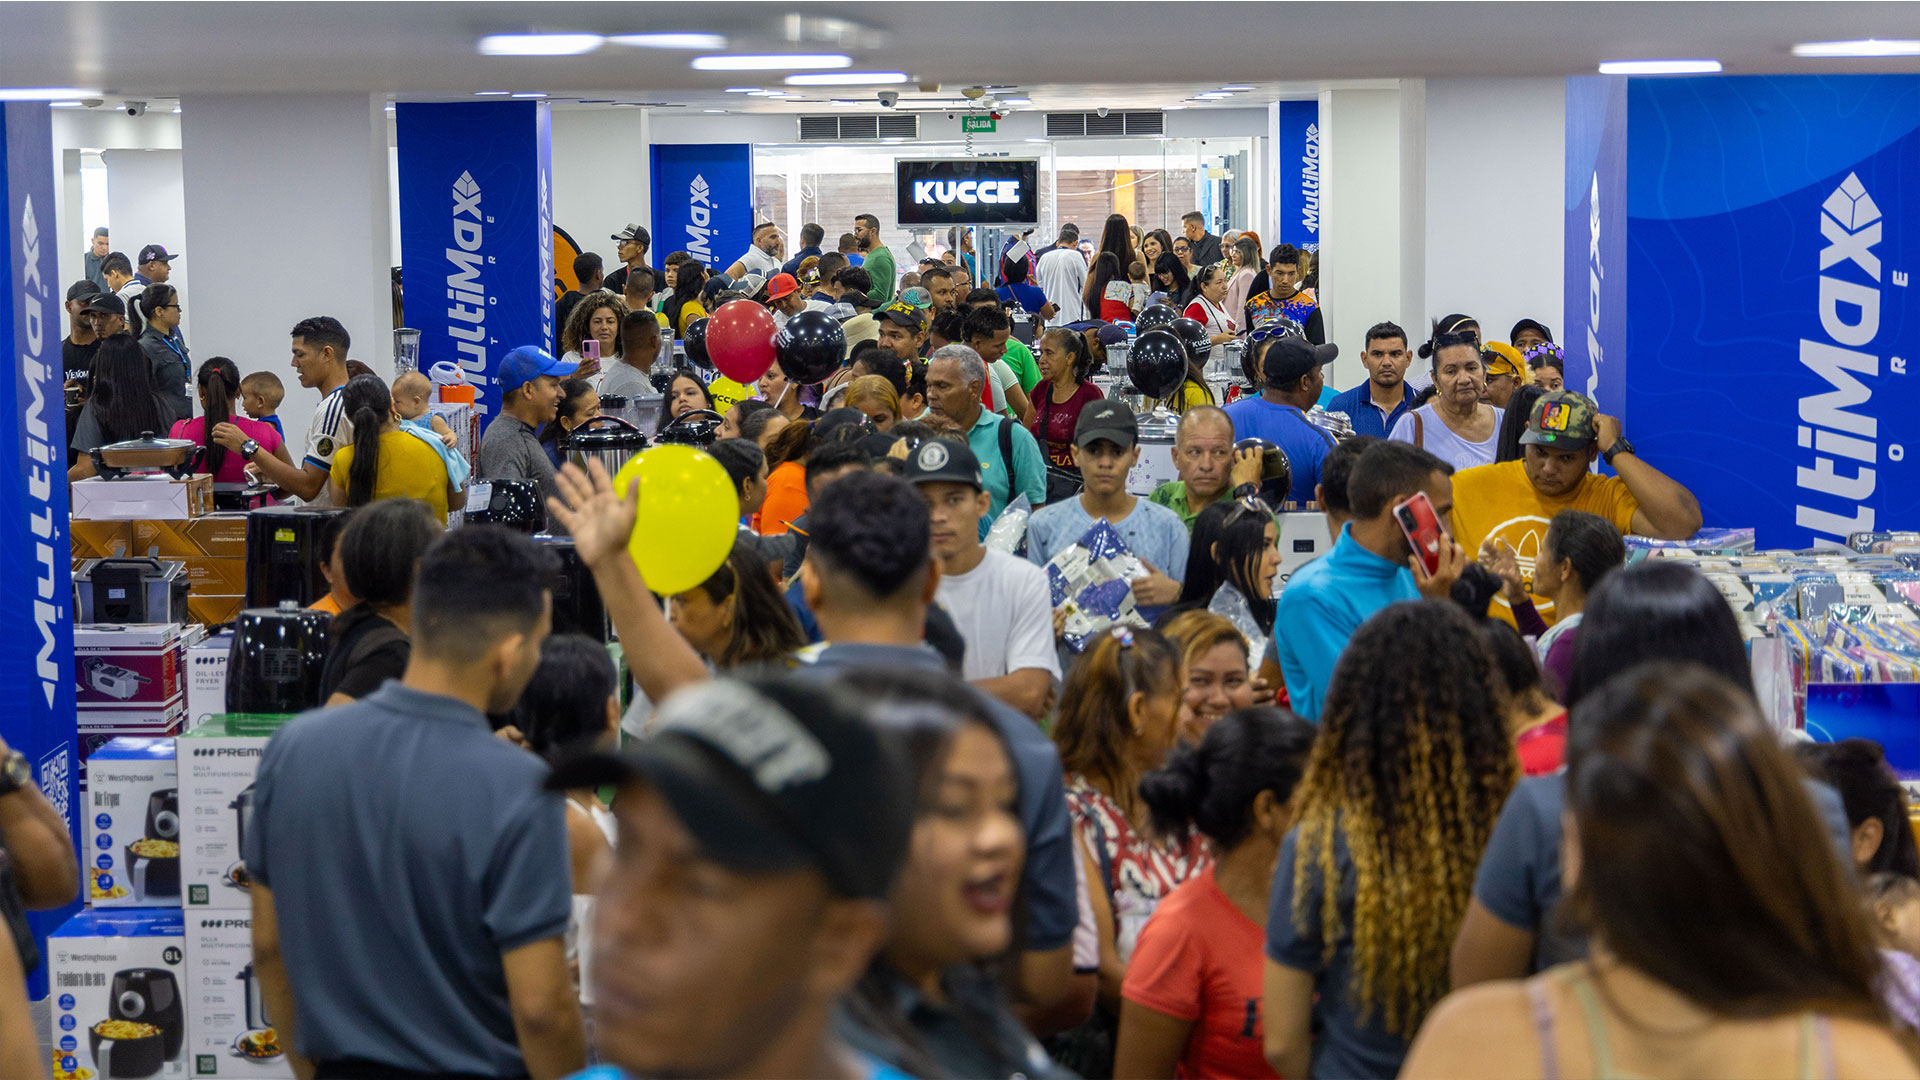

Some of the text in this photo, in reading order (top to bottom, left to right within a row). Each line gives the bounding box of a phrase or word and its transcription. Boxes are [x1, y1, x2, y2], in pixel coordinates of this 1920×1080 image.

[966, 120, 992, 129] SALIDA
[1302, 130, 1319, 229] MultiMax
[914, 180, 1020, 205] KUCCE
[1796, 211, 1882, 556] ltiMax
[22, 231, 58, 682] MultiMax
[108, 774, 154, 784] Westinghouse
[94, 792, 103, 807] Air
[71, 952, 117, 962] Westinghouse
[57, 971, 84, 987] Freidora
[93, 971, 106, 987] aire
